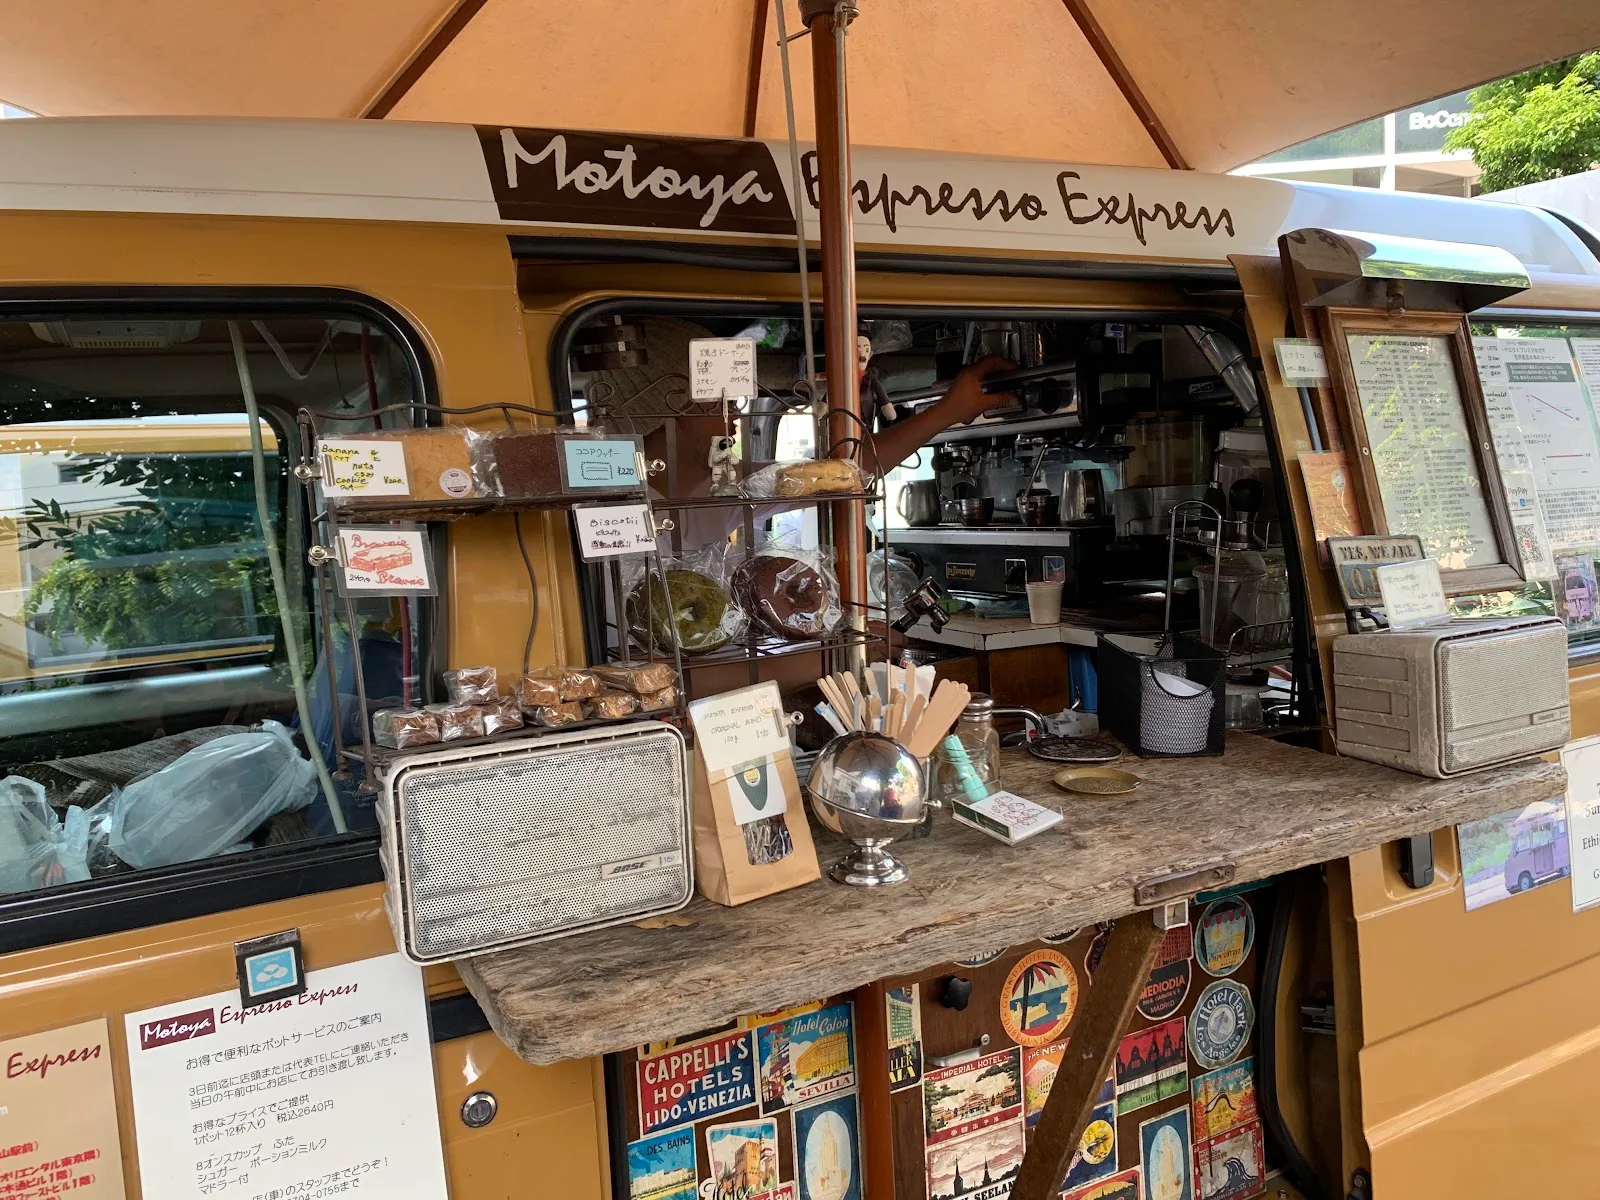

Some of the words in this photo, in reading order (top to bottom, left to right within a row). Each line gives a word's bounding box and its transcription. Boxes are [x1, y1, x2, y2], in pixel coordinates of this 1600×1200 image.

[500, 128, 773, 227] Motoya
[1057, 171, 1235, 246] Express
[321, 444, 360, 455] Banana
[351, 534, 409, 548] Brownie
[1339, 546, 1369, 560] YES,
[1368, 545, 1390, 559] WE
[1392, 544, 1417, 558] ARE
[375, 571, 426, 586] Brownie
[144, 1018, 213, 1043] Motoya
[220, 999, 293, 1025] Espresso
[298, 983, 359, 1006] Express
[1200, 988, 1228, 1020] Hotel
[1228, 990, 1248, 1029] Clark
[792, 1014, 821, 1036] Hotel
[186, 1012, 382, 1071] お得で便利なポットサービスのご案内
[1027, 1049, 1041, 1062] THE
[1041, 1042, 1068, 1057] NEW
[7, 1044, 101, 1079] Express
[644, 1037, 749, 1085] CAPPELLI'S
[940, 1061, 976, 1079] IMPERIAL
[977, 1055, 1003, 1069] HOTEL
[654, 1066, 743, 1104] HOTELS
[799, 1076, 851, 1098] SEVILLA
[192, 1094, 310, 1134] お得なプライスでご提供
[646, 1083, 752, 1128] LIDO-VENEZIA
[193, 1117, 266, 1146] 1ポット12杯入り
[276, 1099, 334, 1123] 税込2640円
[273, 1135, 296, 1149] ふた
[647, 1143, 664, 1156] DES
[667, 1135, 691, 1149] BAINS
[197, 1166, 238, 1185] シュガー
[249, 1138, 328, 1169] ポーションミルク
[199, 1172, 249, 1196] マドラー付
